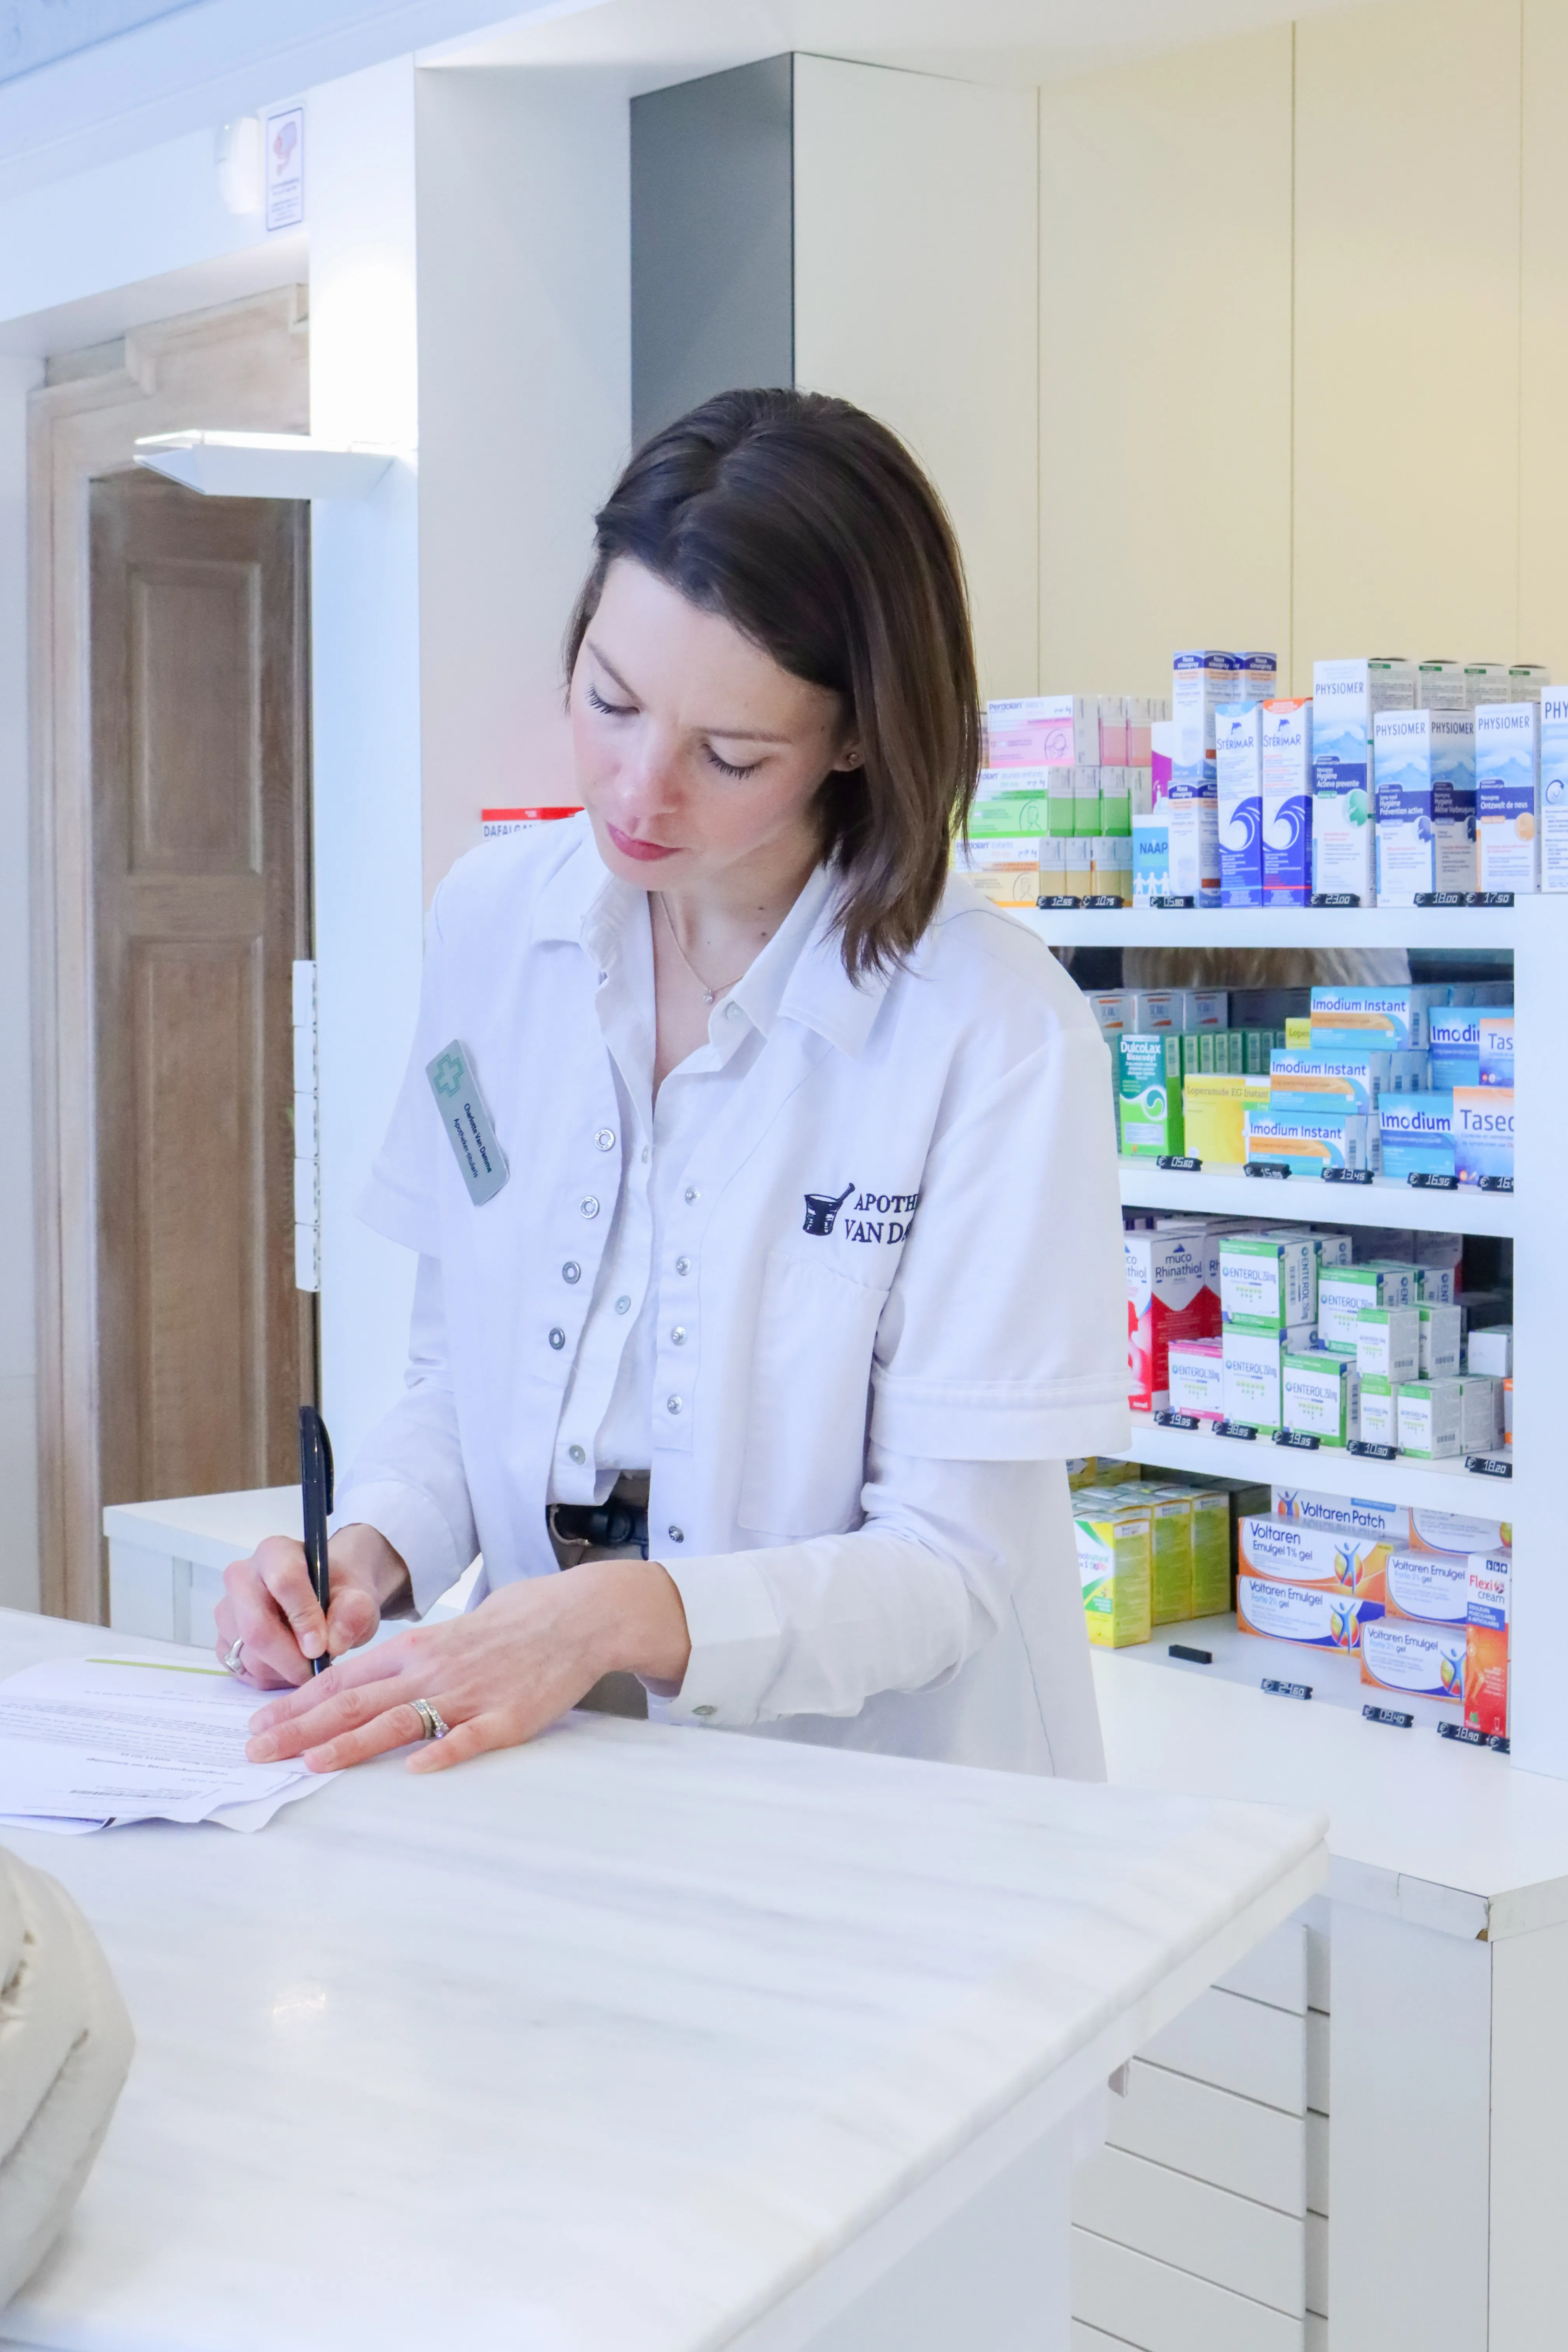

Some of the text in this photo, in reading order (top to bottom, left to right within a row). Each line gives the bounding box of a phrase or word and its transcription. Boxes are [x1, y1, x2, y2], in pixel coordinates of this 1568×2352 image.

[1316, 682, 1364, 696] PHYSIOMER
[989, 701, 1022, 710] Perdolan
[1376, 722, 1426, 737] PHYSIOMER
[1432, 722, 1474, 734] PHYSIOMER
[1479, 716, 1530, 730] PHYSIOMER
[1506, 801, 1513, 809] de
[1313, 998, 1406, 1012] Imodium Instant
[1120, 1041, 1161, 1054] DulcoLax
[1488, 1033, 1513, 1050] Tas
[1272, 1061, 1366, 1076] Imodium Instant
[1187, 1086, 1269, 1098] Loperamide EG Instant
[1381, 1111, 1451, 1131] Imodium
[463, 1103, 478, 1134] Charlotte
[479, 1146, 492, 1173] Damme
[1250, 1123, 1342, 1139] Imodium Instant
[454, 1117, 478, 1178] Apotheker-titularis
[1497, 1177, 1514, 1189] 16.
[845, 1219, 884, 1243] VAN
[1166, 1253, 1192, 1264] muco
[1155, 1261, 1202, 1278] Rhinathiol
[1230, 1267, 1262, 1280] ENTEROL
[1302, 1258, 1310, 1301] ENTEROL
[1328, 1295, 1358, 1308] ENTEROL
[1179, 1365, 1206, 1378] ENTEROL
[1233, 1361, 1263, 1374] ENTEROL
[1293, 1383, 1324, 1397] ENTEROL
[1301, 1500, 1385, 1530] Voltaren Patch
[1251, 1522, 1301, 1545] Voltaren
[1253, 1540, 1285, 1556] Emulgel
[1299, 1550, 1313, 1561] gel
[1392, 1559, 1465, 1581] Voltaren Emulgel
[1470, 1574, 1493, 1591] Flexi
[1249, 1580, 1323, 1606] Voltaren Emulgel
[1478, 1591, 1505, 1604] cream
[1279, 1600, 1289, 1609] gel
[1368, 1627, 1438, 1651] Voltaren Emulgel
